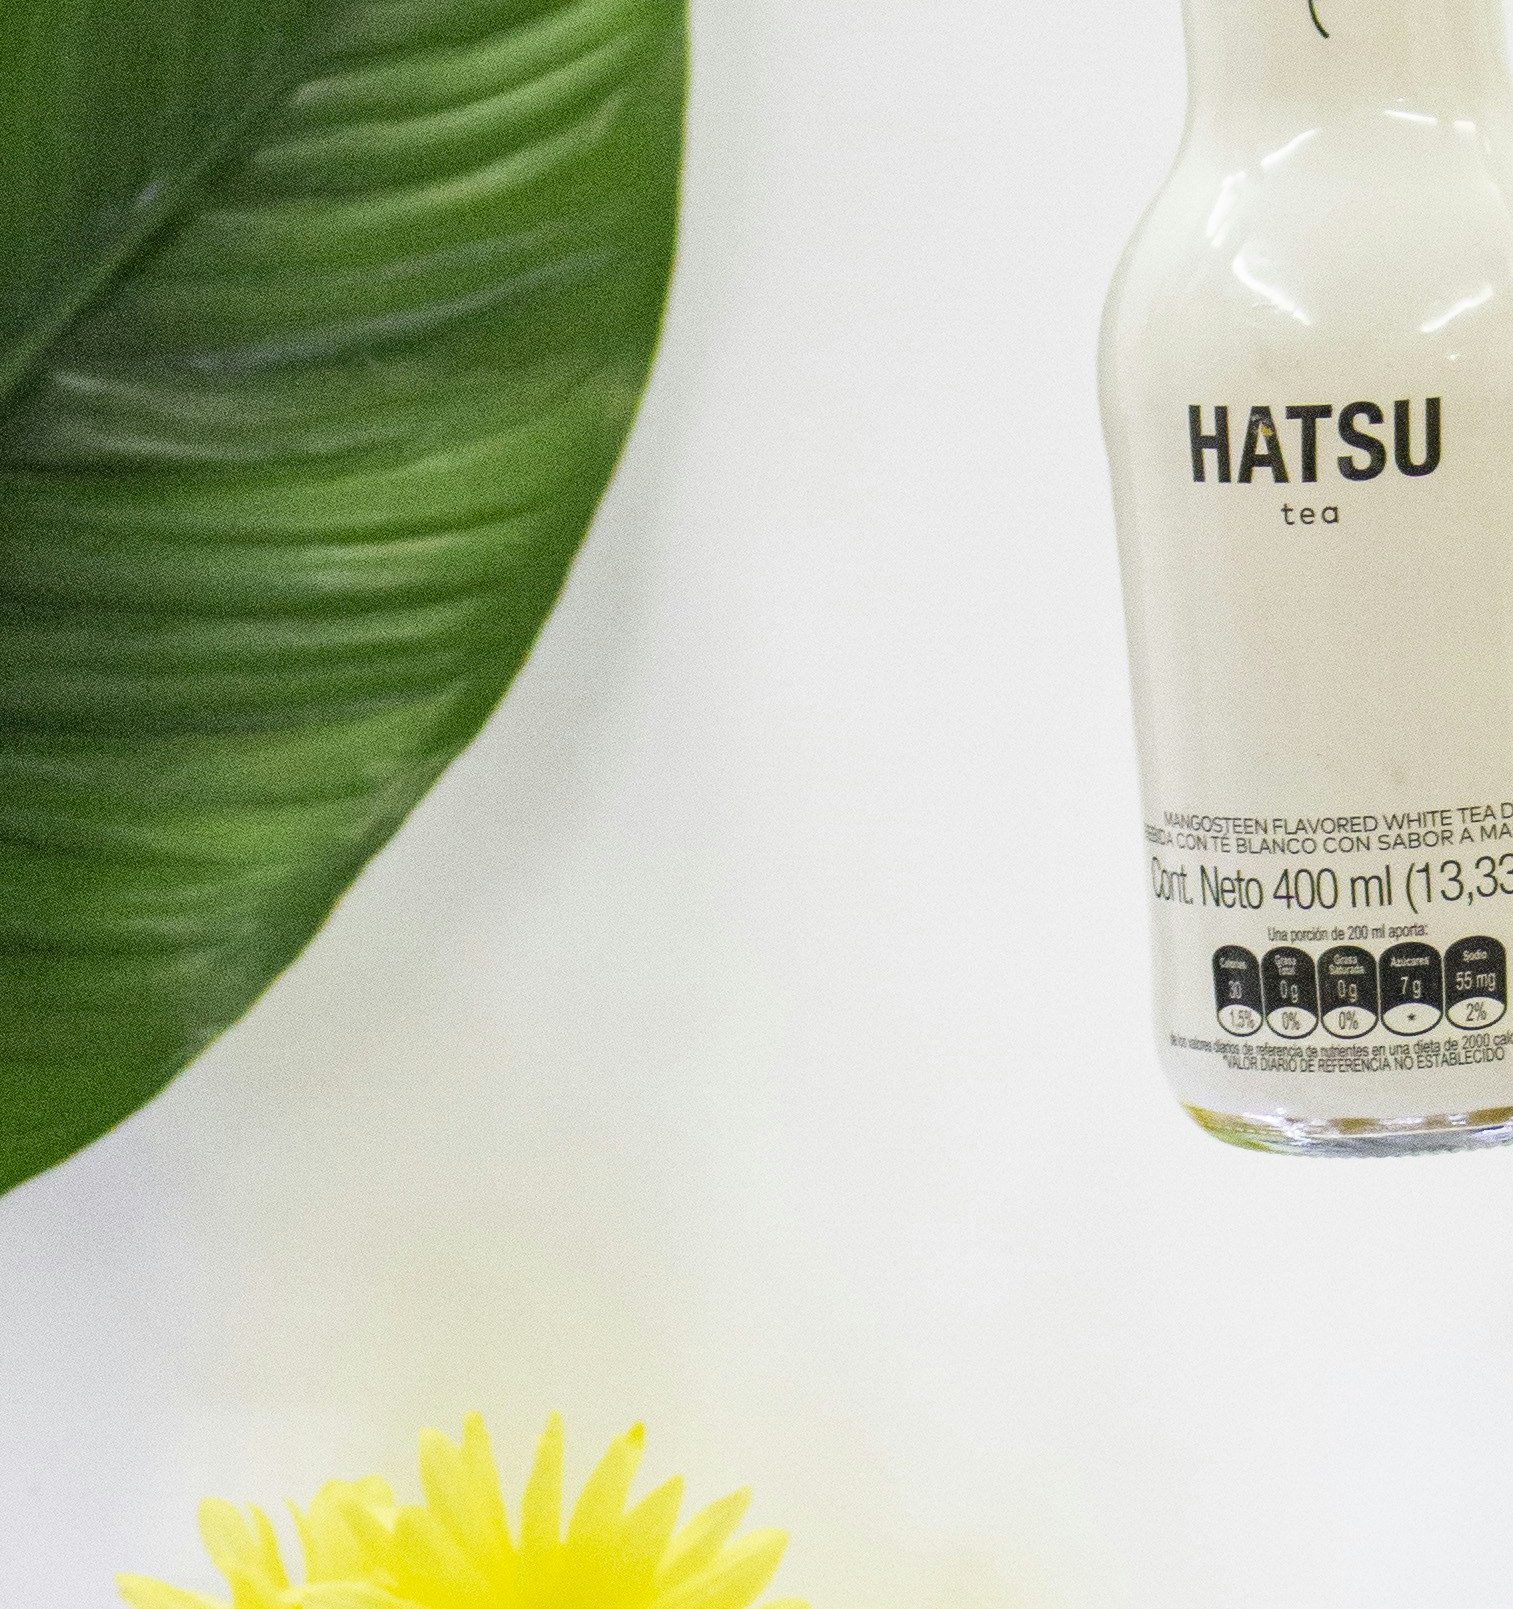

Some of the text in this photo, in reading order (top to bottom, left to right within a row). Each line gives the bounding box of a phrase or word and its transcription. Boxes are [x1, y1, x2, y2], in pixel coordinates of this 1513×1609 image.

[1188, 396, 1442, 484] HATSU
[1281, 503, 1339, 525] tea
[1164, 811, 1268, 835] MANGOSTEEN
[1273, 816, 1378, 835] FLAVORED
[1383, 808, 1452, 830] WHITE
[1457, 804, 1496, 824] TEA
[1177, 832, 1207, 851] CON
[1236, 837, 1317, 854] BLANCO
[1323, 836, 1370, 854] CON
[1378, 829, 1454, 851] SABOR
[1460, 827, 1474, 843] A
[1151, 856, 1193, 905] Cont.
[1200, 864, 1264, 909] Neto
[1273, 868, 1338, 909] 400
[1350, 863, 1392, 907] ml
[1267, 926, 1287, 941] Una
[1290, 926, 1329, 944] porción
[1332, 926, 1345, 940] de
[1349, 925, 1368, 940] 200
[1372, 924, 1386, 939] ml
[1400, 976, 1422, 999] 7 g
[1456, 971, 1496, 992] 55 mg
[1282, 1011, 1300, 1031] 0%
[1338, 1010, 1359, 1031] 0%
[1465, 1000, 1488, 1022] 2%
[1394, 1055, 1414, 1071] NO
[1417, 1047, 1505, 1070] ESTABLECIDO
